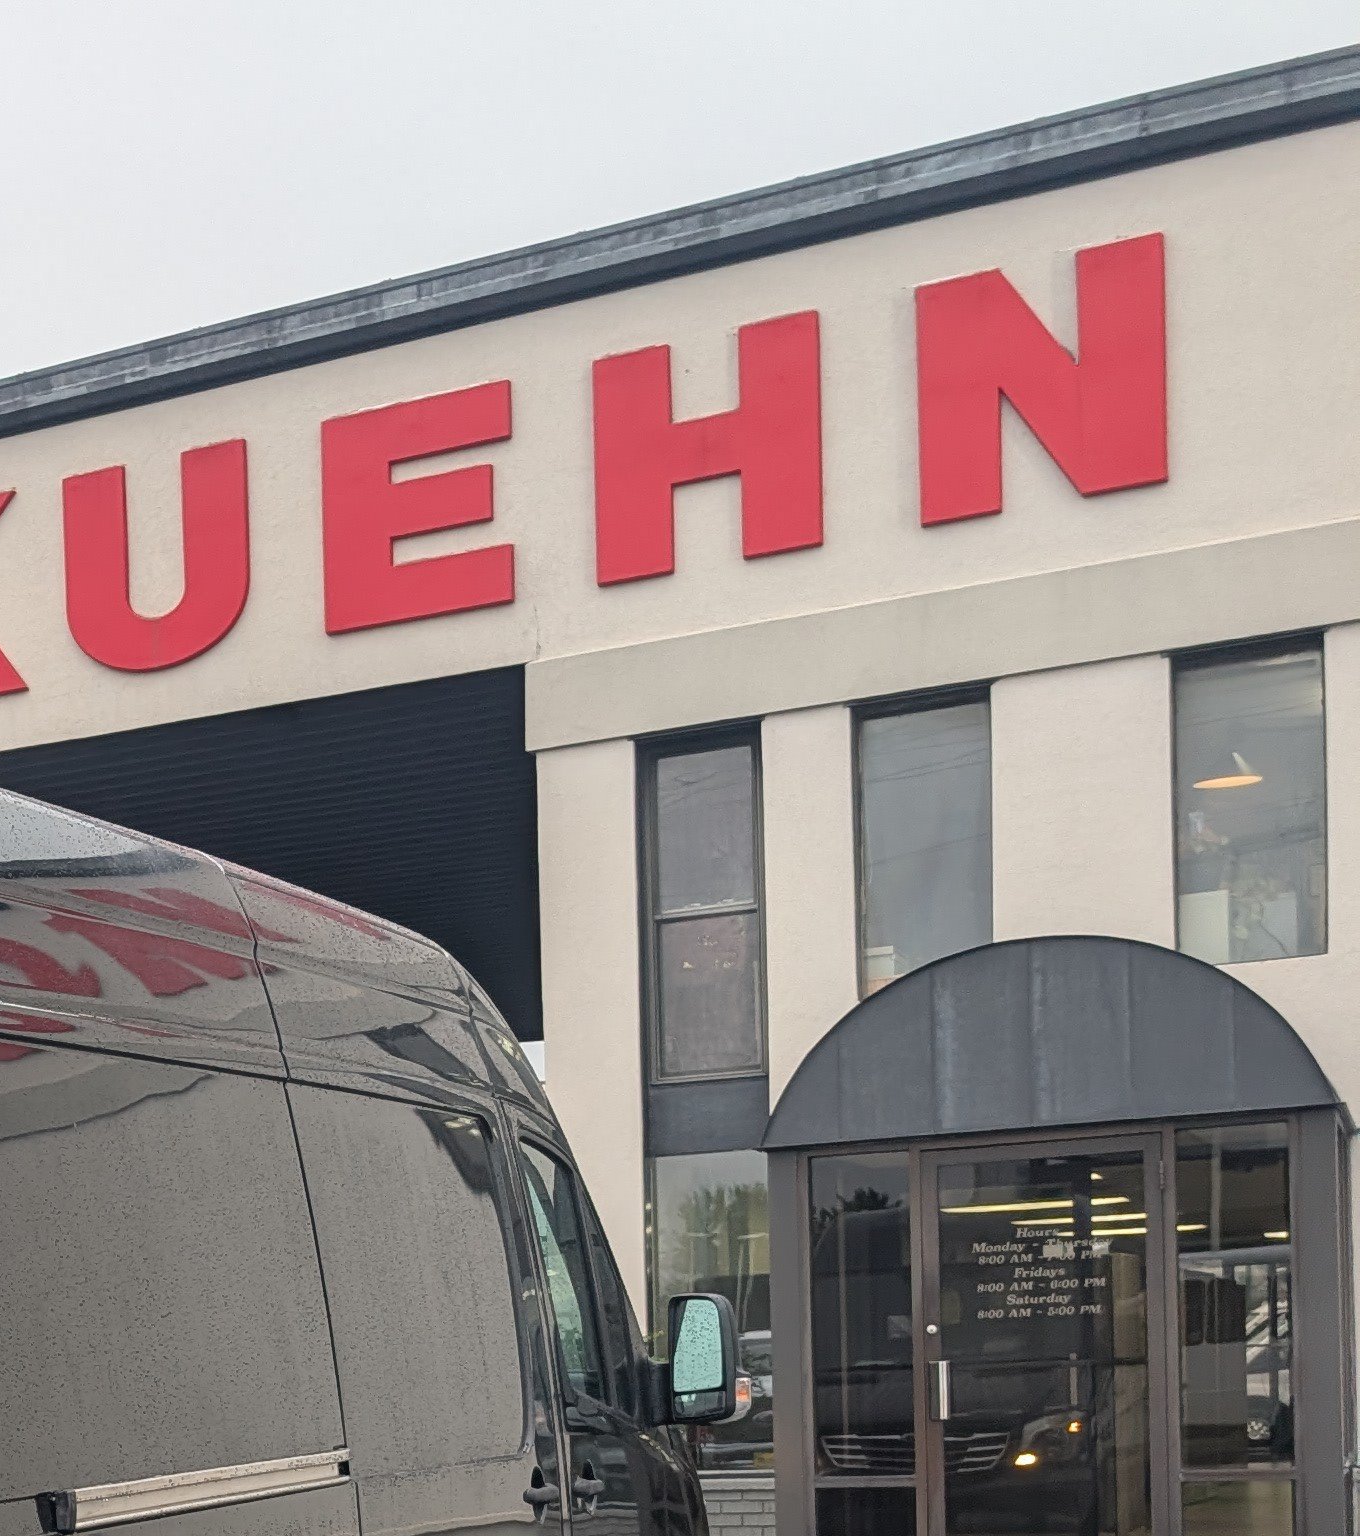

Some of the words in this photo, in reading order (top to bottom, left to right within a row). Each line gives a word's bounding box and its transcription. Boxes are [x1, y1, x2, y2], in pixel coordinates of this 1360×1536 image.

[1016, 1227, 1059, 1238] Hours
[972, 1241, 1026, 1253] Monday
[978, 1255, 1005, 1265] 8:00
[1010, 1253, 1033, 1263] AM
[1013, 1266, 1066, 1278] Fridays
[977, 1283, 1004, 1293] 8:00
[1010, 1281, 1033, 1291] AM
[1084, 1277, 1106, 1287] PM
[1006, 1293, 1072, 1305] Saturday
[977, 1309, 1004, 1319] 8:00
[1008, 1308, 1031, 1318] AM
[1080, 1304, 1102, 1314] PM
